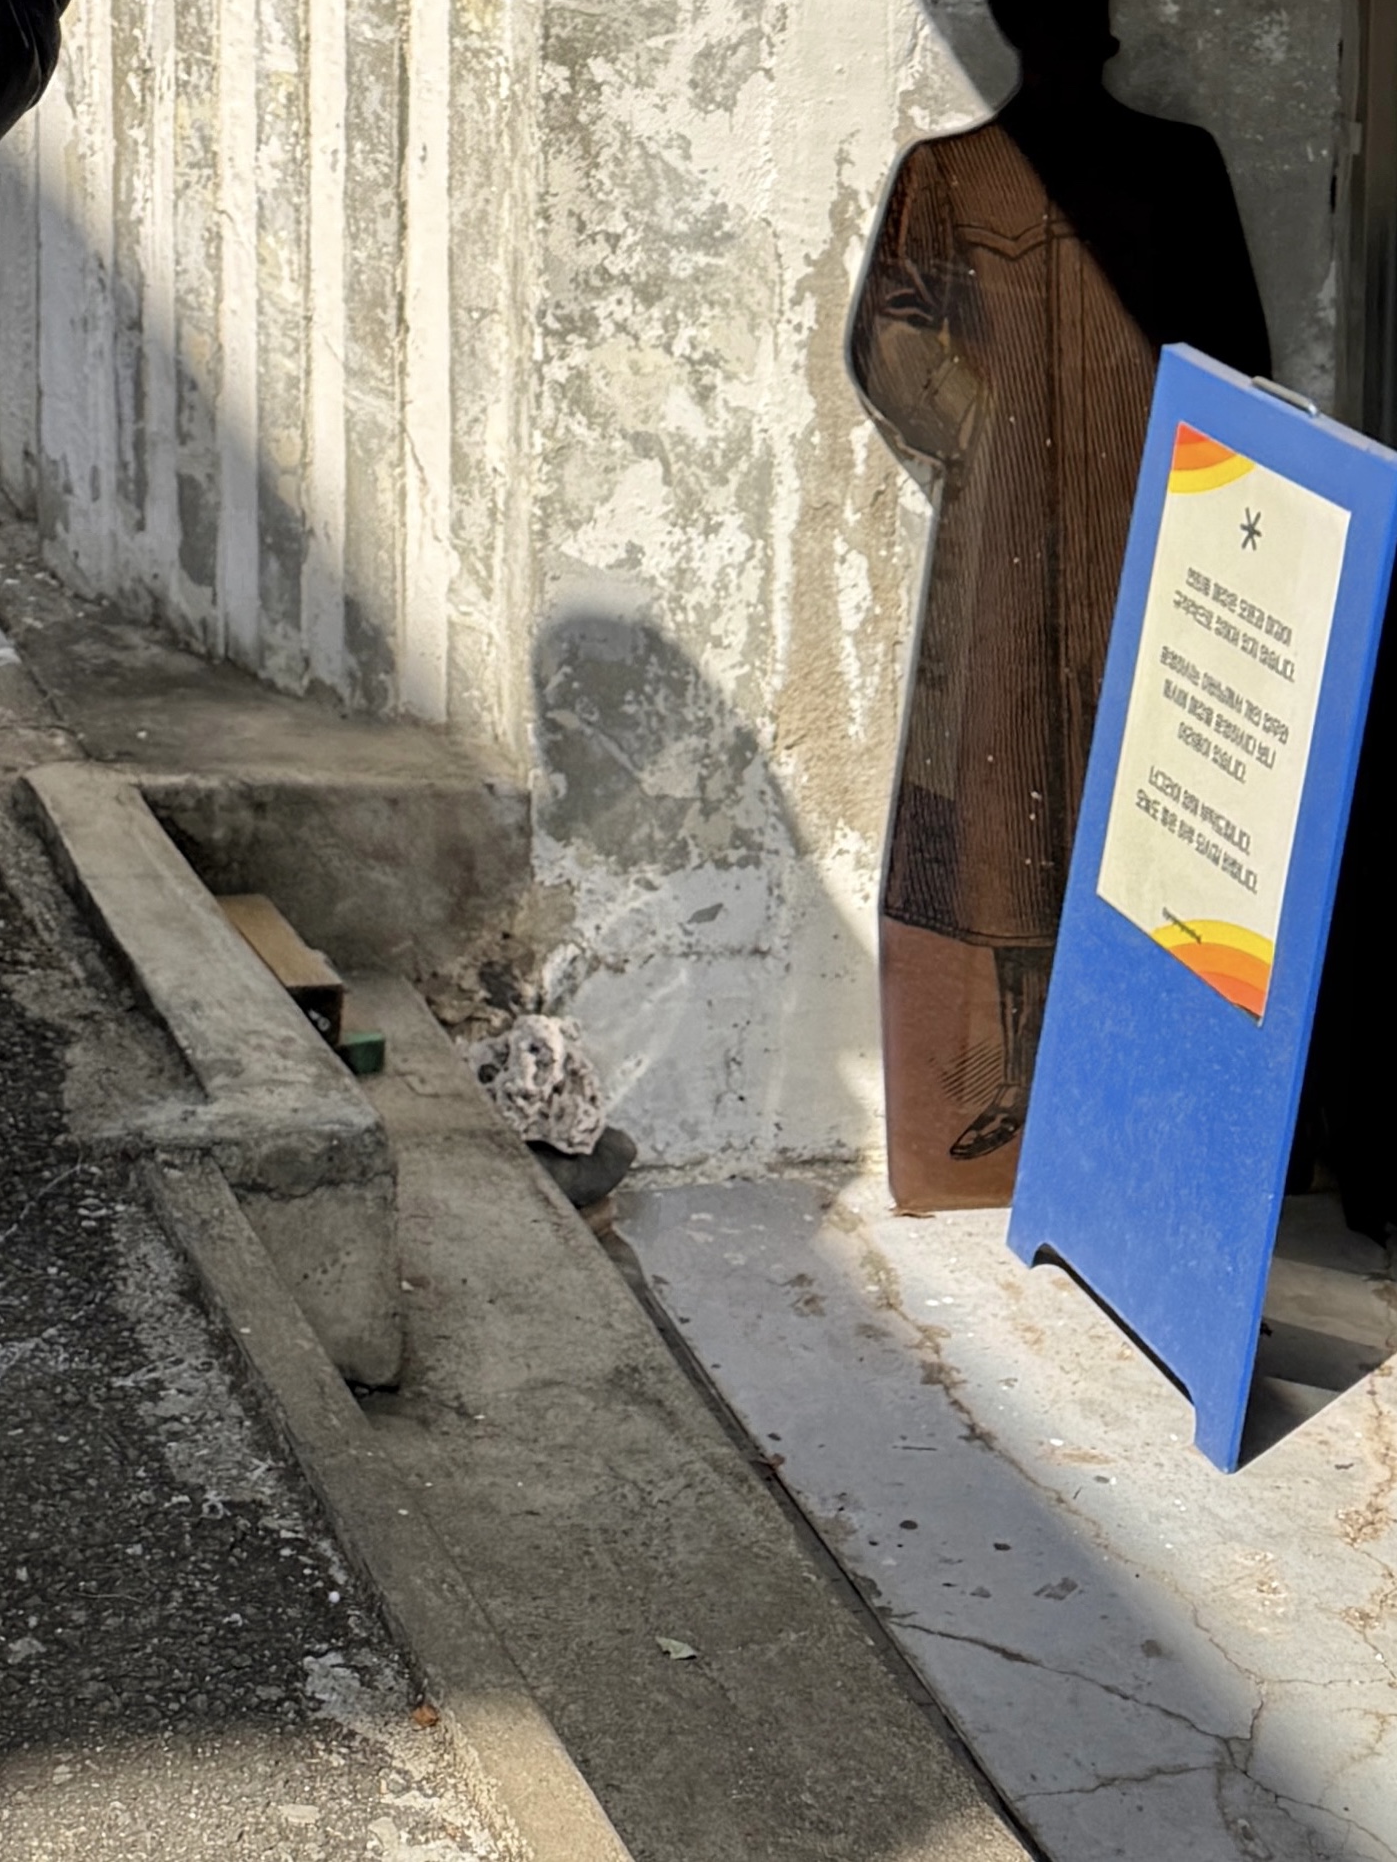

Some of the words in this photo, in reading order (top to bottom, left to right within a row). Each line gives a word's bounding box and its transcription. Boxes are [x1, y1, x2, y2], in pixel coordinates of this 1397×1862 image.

[1211, 582, 1237, 613] 매장은
[1240, 632, 1258, 659] 있지
[1243, 699, 1261, 727] 개인
[1255, 741, 1276, 769] 보니
[1148, 765, 1181, 803] 너그러이
[1181, 789, 1199, 816] 양해
[1135, 788, 1160, 820] 오늘도
[1160, 806, 1177, 833] 좋은
[1177, 819, 1195, 843] 하루
[1194, 832, 1222, 866] 되시길
